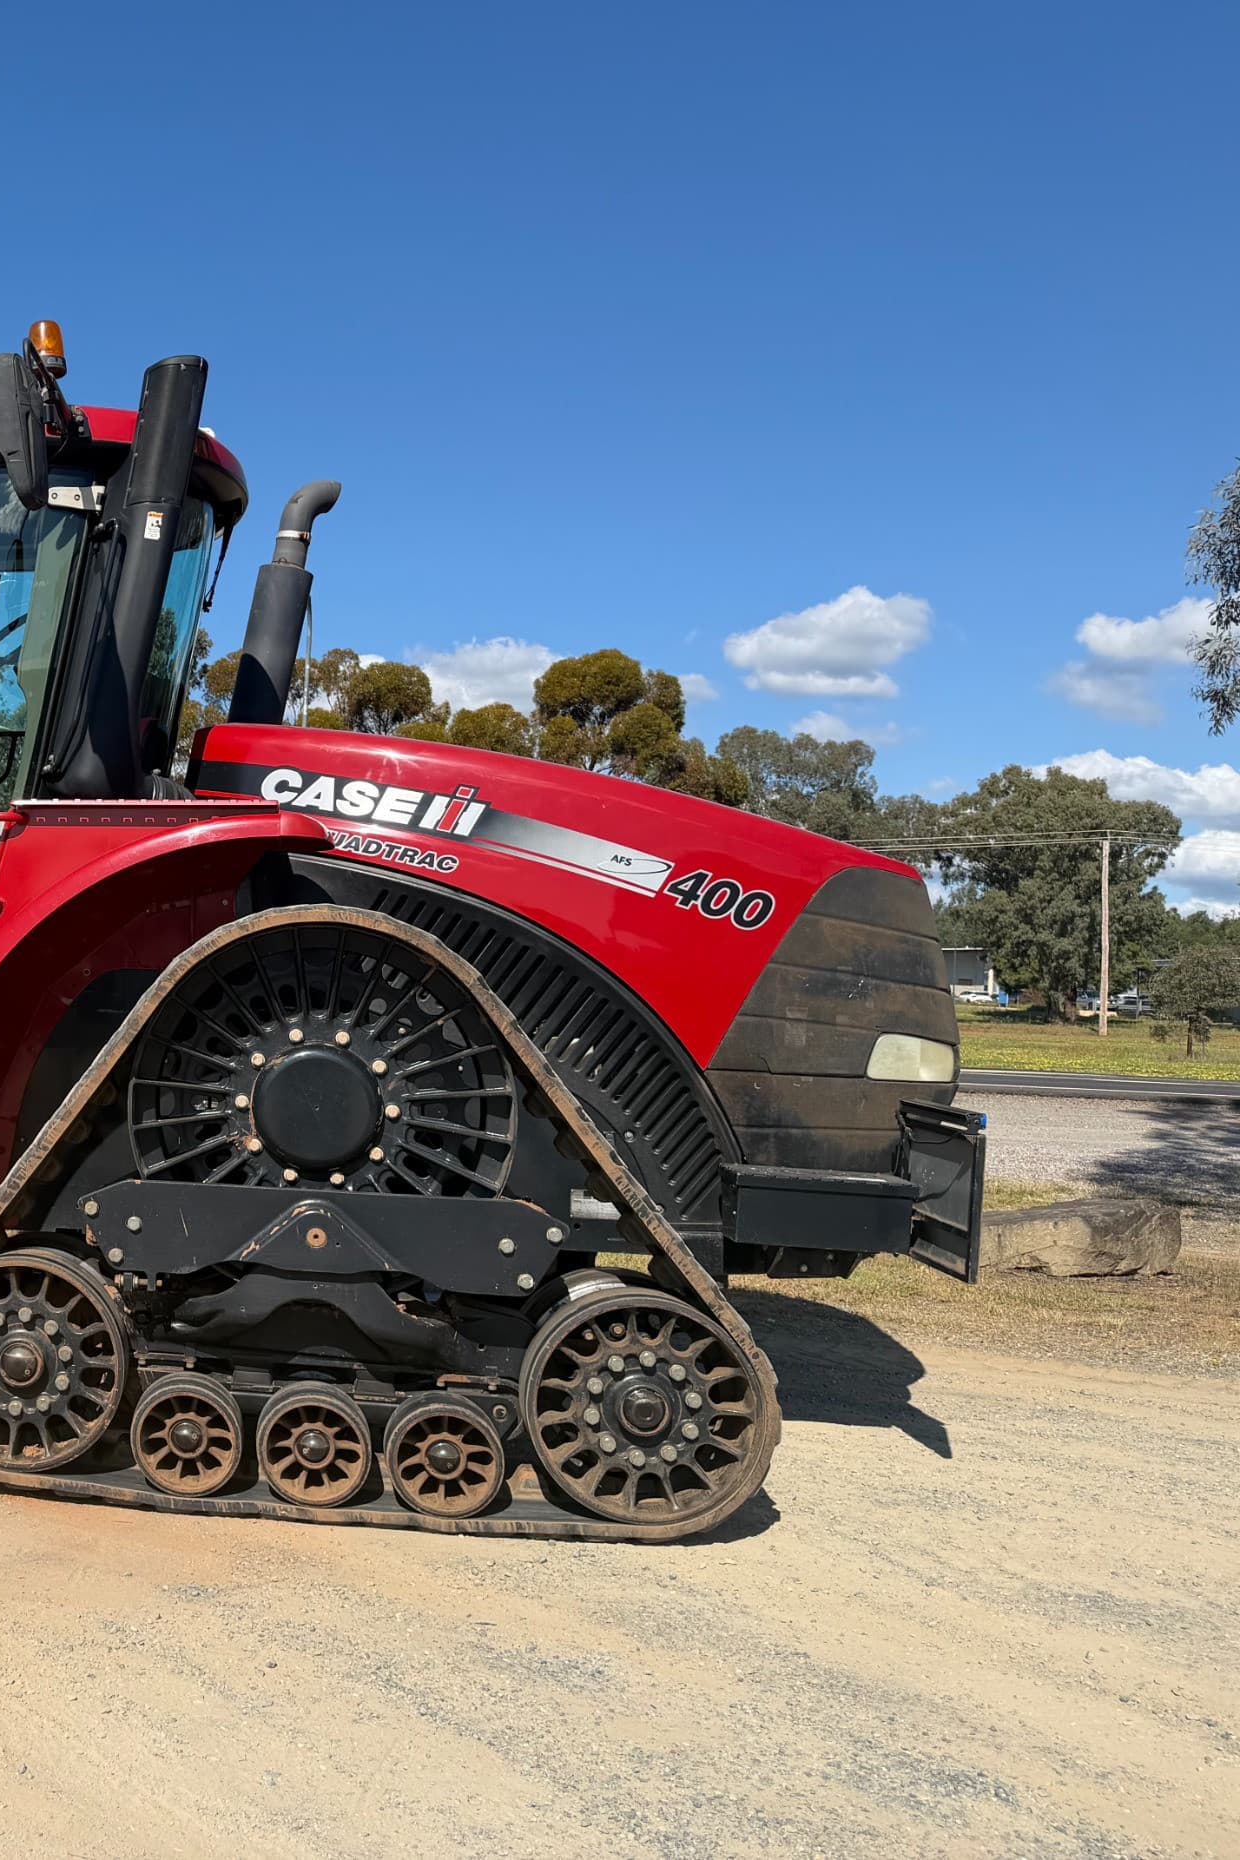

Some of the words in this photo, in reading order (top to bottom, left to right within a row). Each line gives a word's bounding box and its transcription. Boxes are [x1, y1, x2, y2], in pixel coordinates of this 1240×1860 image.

[261, 768, 424, 826] CASE
[326, 831, 459, 873] UADTRAC
[610, 854, 633, 867] AFS
[664, 869, 776, 931] 400
